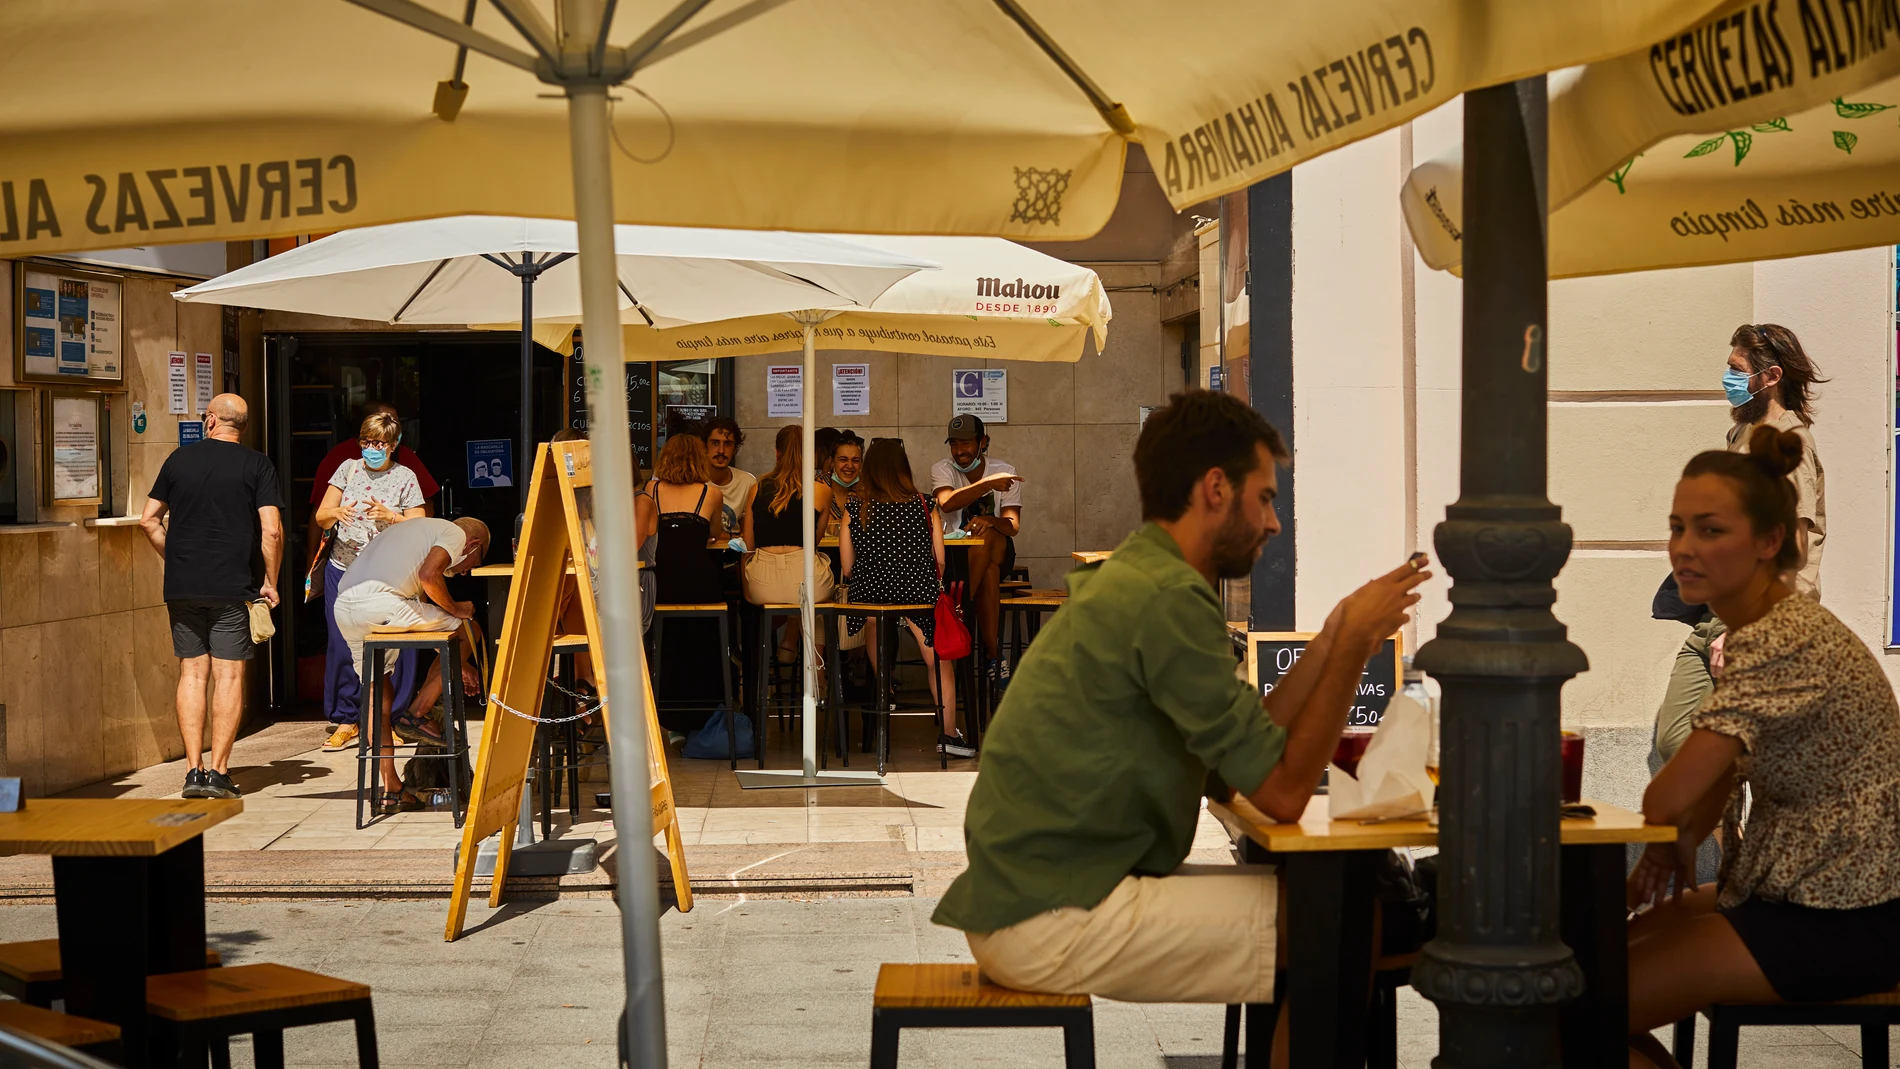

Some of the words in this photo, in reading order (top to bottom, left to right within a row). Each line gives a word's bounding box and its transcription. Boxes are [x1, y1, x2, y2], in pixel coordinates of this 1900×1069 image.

[1649, 0, 1794, 117] CERVEZAS
[976, 276, 1060, 300] Mahou
[975, 302, 1020, 313] DESDE
[1026, 304, 1058, 314] 1890
[960, 371, 979, 397] C
[573, 390, 581, 403] 6
